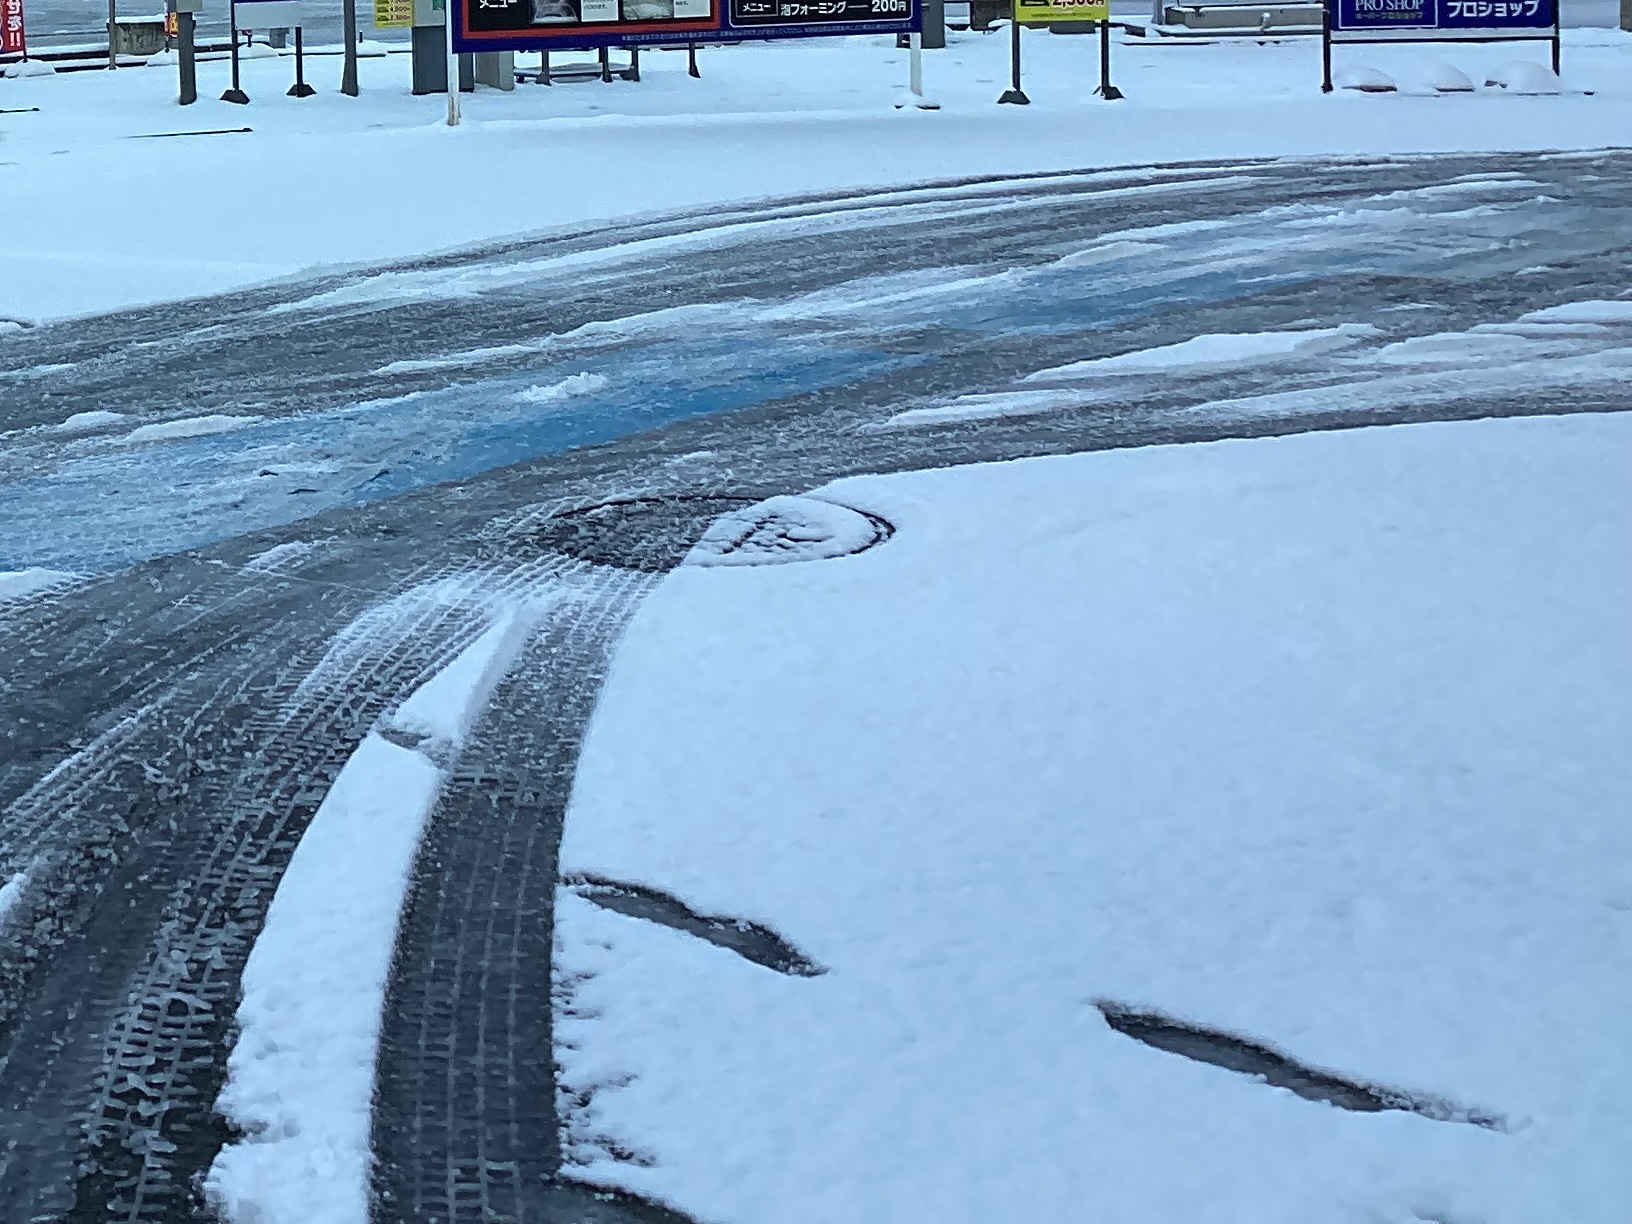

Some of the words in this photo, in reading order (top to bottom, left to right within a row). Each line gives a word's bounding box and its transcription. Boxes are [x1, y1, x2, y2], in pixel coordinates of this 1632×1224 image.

[742, 3, 771, 12] メニュー
[780, 1, 846, 16] 泡フォーミング
[1447, 0, 1539, 18] プロショップ
